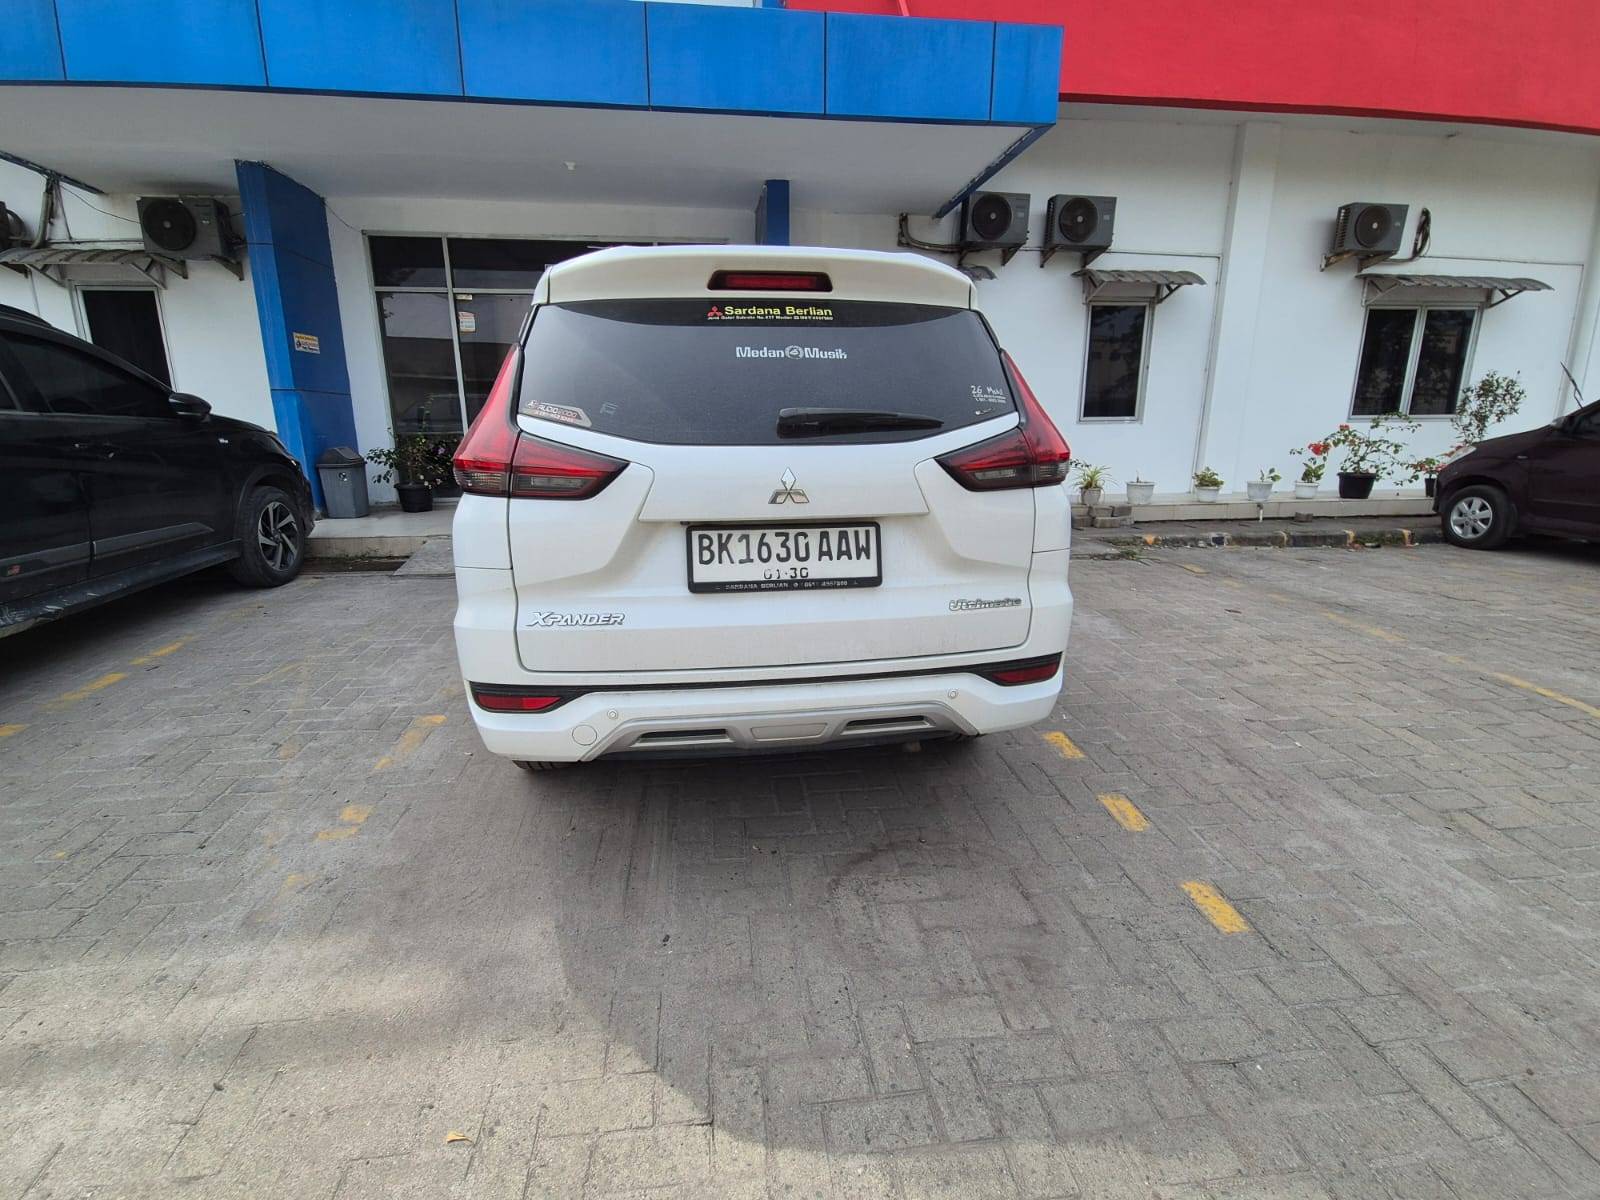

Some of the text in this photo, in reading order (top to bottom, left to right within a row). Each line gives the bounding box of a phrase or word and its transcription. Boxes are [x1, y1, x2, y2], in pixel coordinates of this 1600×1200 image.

[724, 306, 833, 316] Sardana Berlian
[735, 346, 848, 360] Medan Musik
[817, 529, 872, 562] AAW
[525, 611, 626, 627] XPANDER
